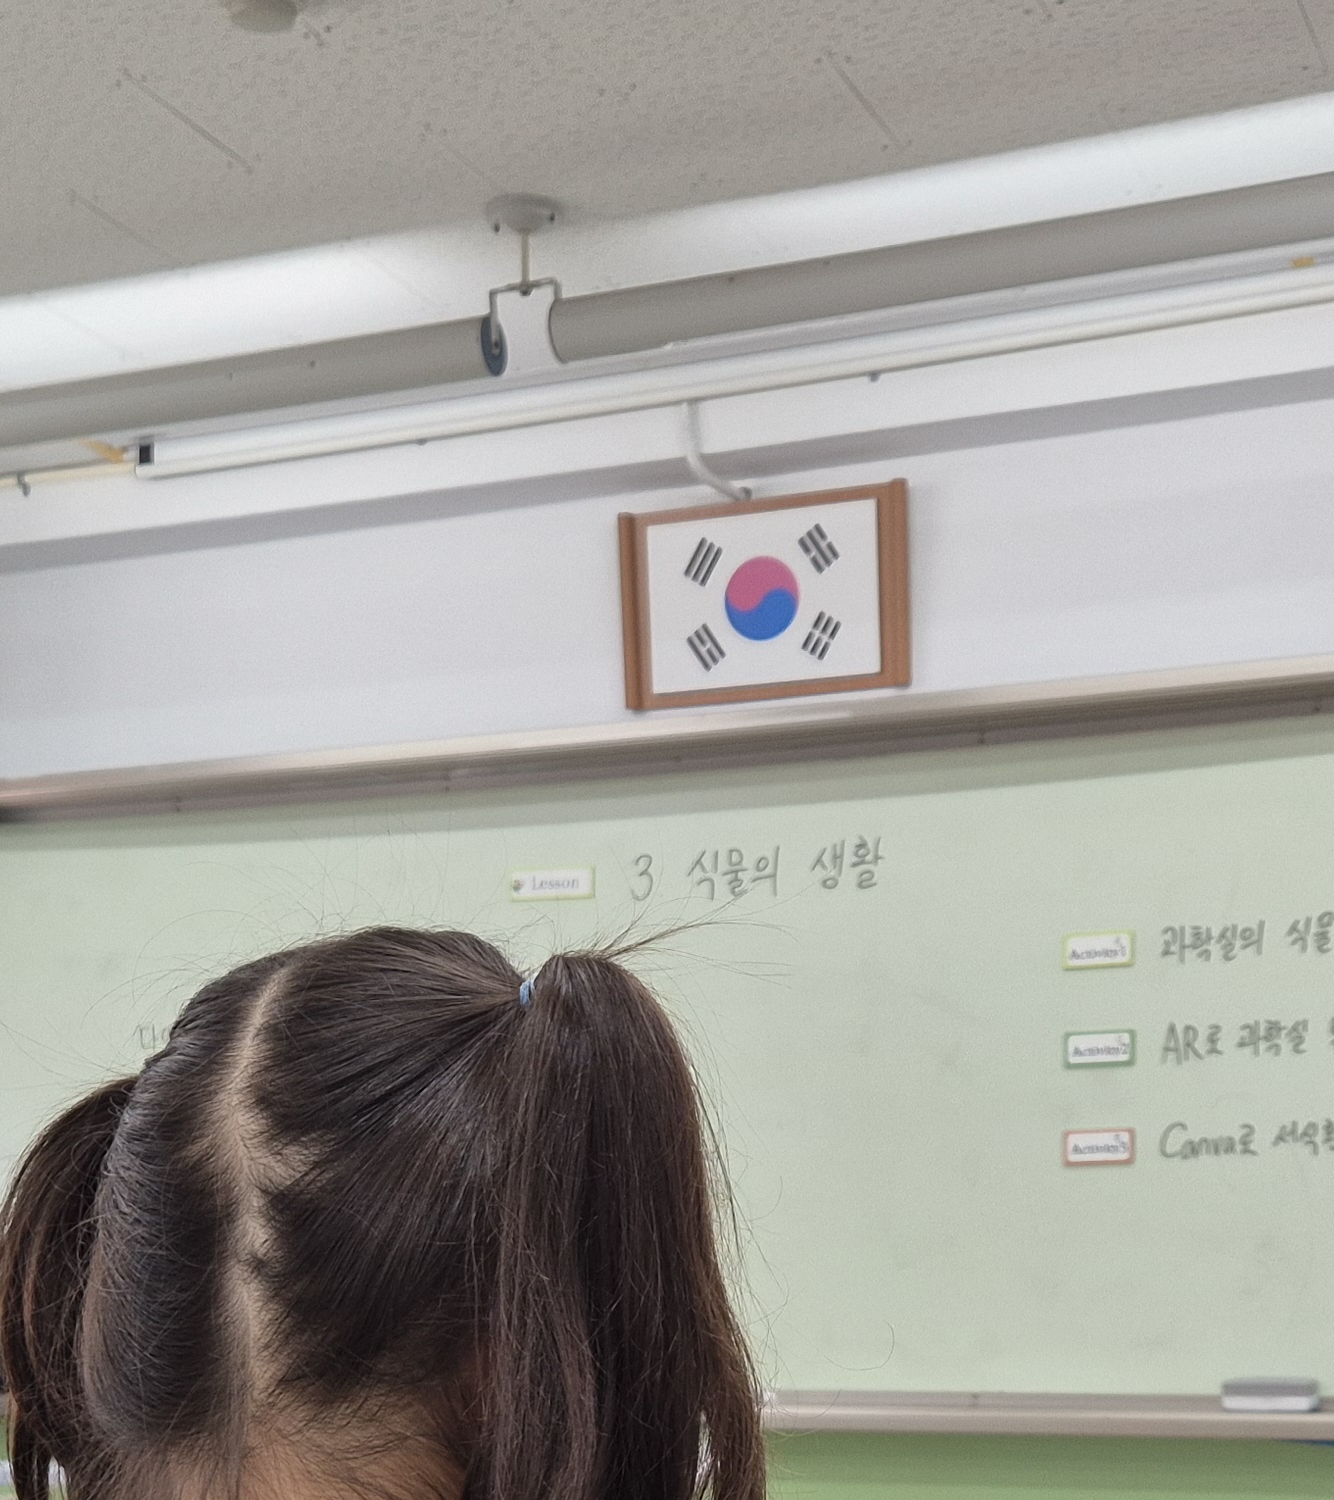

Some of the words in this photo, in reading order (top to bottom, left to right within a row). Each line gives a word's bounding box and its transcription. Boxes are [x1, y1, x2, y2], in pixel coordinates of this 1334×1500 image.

[531, 876, 580, 892] Lesson
[630, 854, 654, 902] 3
[687, 845, 781, 902] 식물의
[810, 834, 886, 890] 생활
[1160, 918, 1267, 965] 과학실의
[1161, 1020, 1224, 1066] AR로
[1235, 1016, 1310, 1058] 과학실
[1159, 1119, 1259, 1160] Canva로
